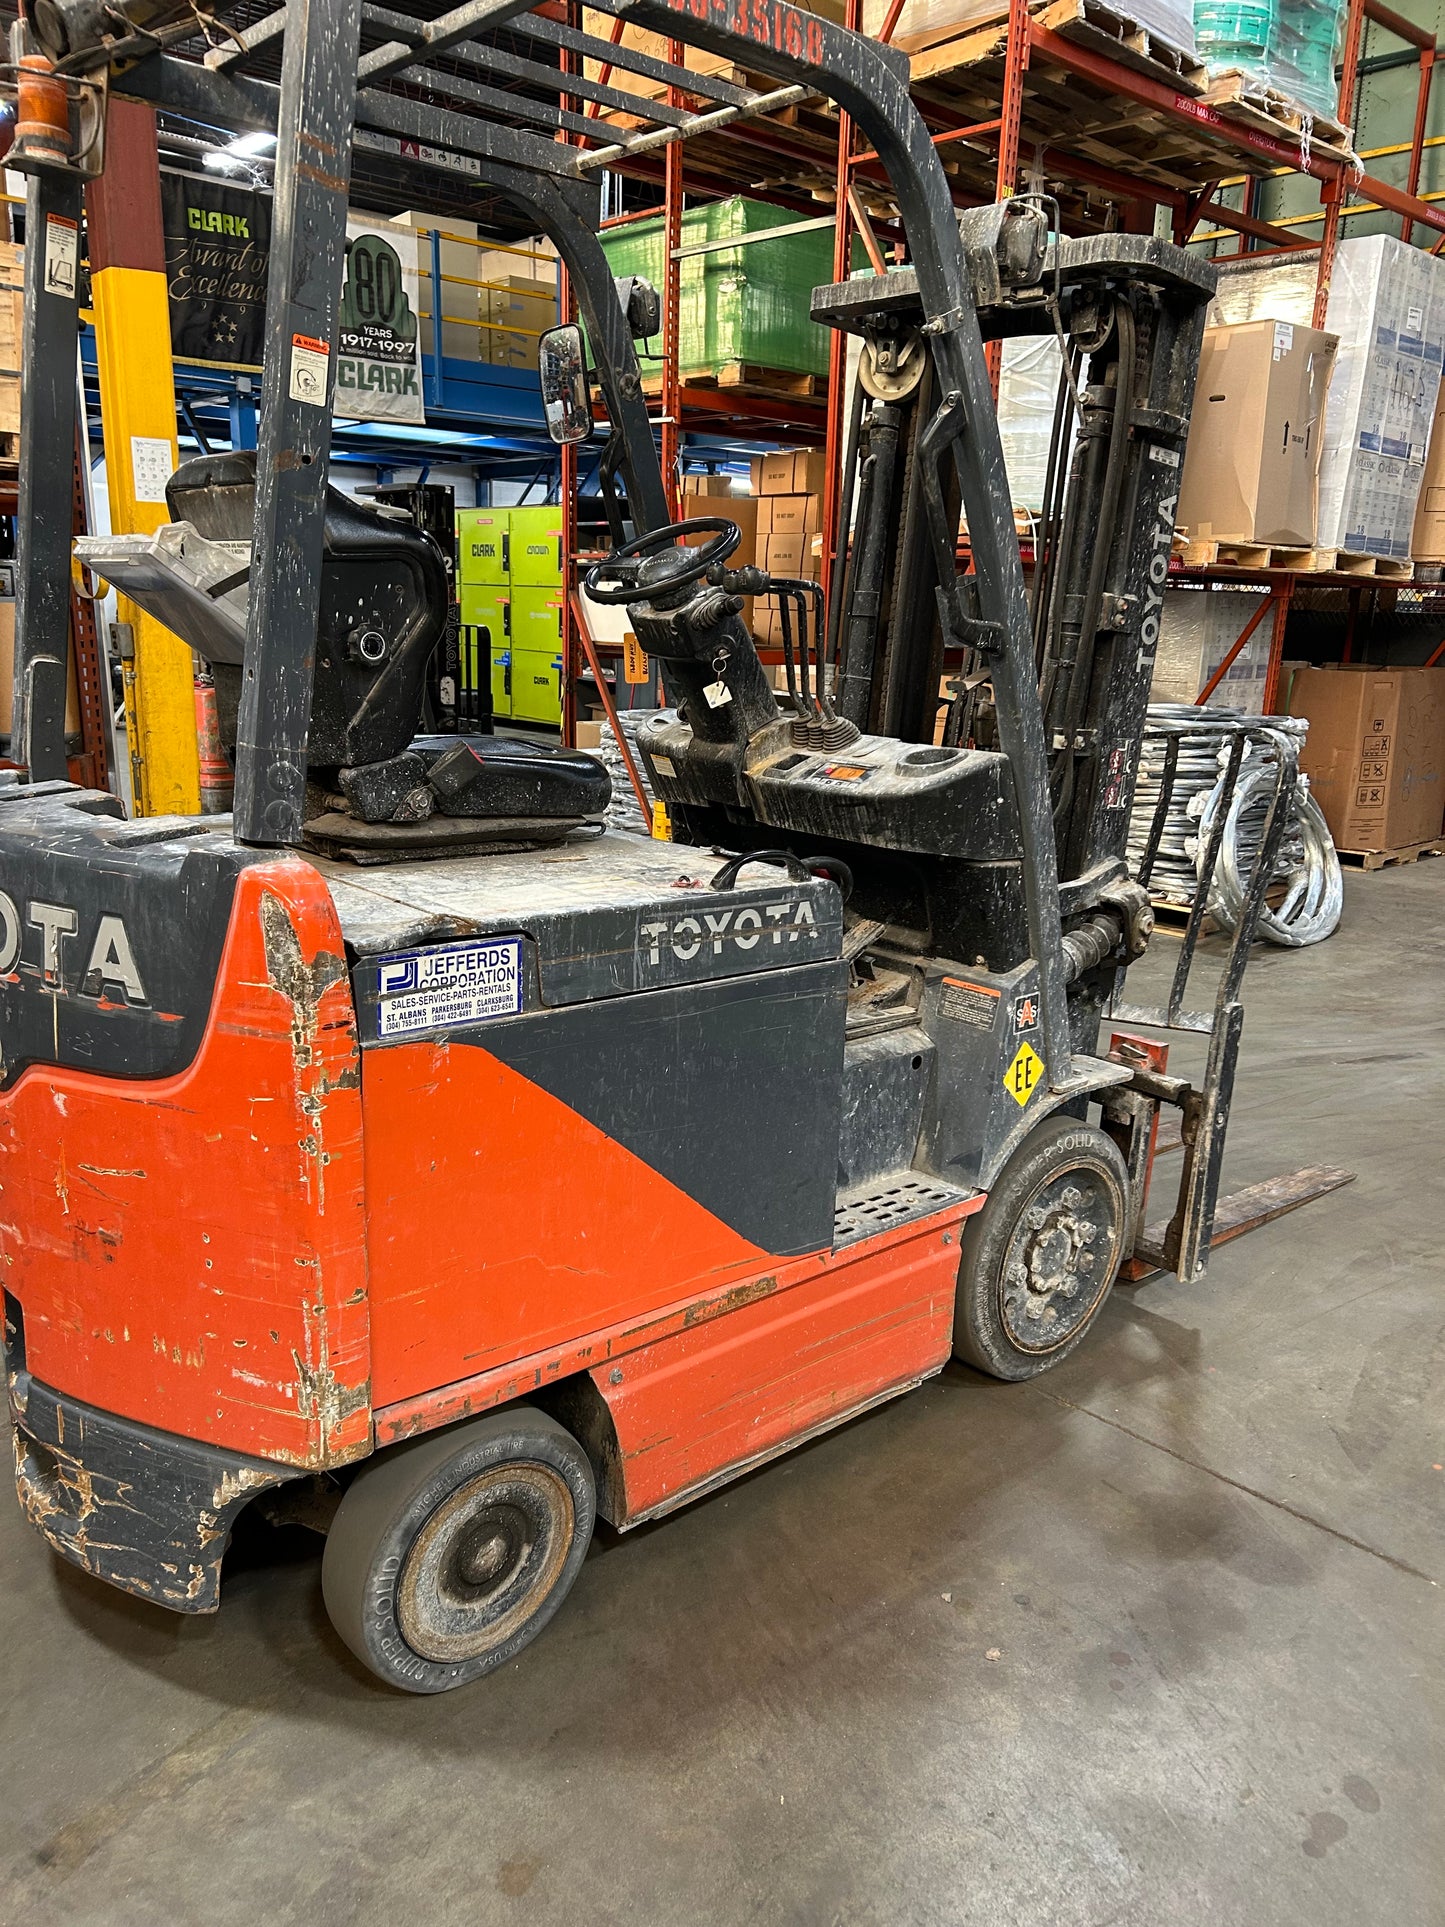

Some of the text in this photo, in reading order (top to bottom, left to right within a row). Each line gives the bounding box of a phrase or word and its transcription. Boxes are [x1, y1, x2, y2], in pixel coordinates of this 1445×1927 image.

[187, 207, 250, 238] CLARK
[166, 238, 255, 271] Award
[355, 248, 395, 322] 80
[340, 333, 415, 353] 1917-1997
[363, 325, 393, 339] YEARS
[338, 359, 419, 395] CLARK
[1357, 526, 1365, 535] 18
[1384, 530, 1391, 539] 18
[472, 544, 495, 557] CLARK
[1136, 494, 1177, 673] TOYOTA
[534, 676, 549, 685] CLARK
[640, 900, 818, 965] TOYOTA
[425, 948, 510, 977] JEFFERDS
[420, 966, 515, 992] CORPORATION
[386, 994, 514, 1023] ST. ALBANS PARKERSBURG CLARKSBURG
[391, 983, 511, 1011] SALES-SERVICE-PARTS-RENTALS
[386, 1022, 401, 1032] (304)
[432, 1014, 446, 1023] (304)
[447, 1010, 472, 1021] 422-6491
[476, 1007, 489, 1016] (304)
[1016, 999, 1038, 1028] SAS
[1015, 1056, 1033, 1093] EE
[1012, 1133, 1094, 1196] SUPER SOLID
[411, 1480, 451, 1520] MITCHELL
[452, 1445, 503, 1477] INDUSTRIAL
[375, 1555, 431, 1681] SUPER SOLID
[478, 1649, 503, 1669] USA
